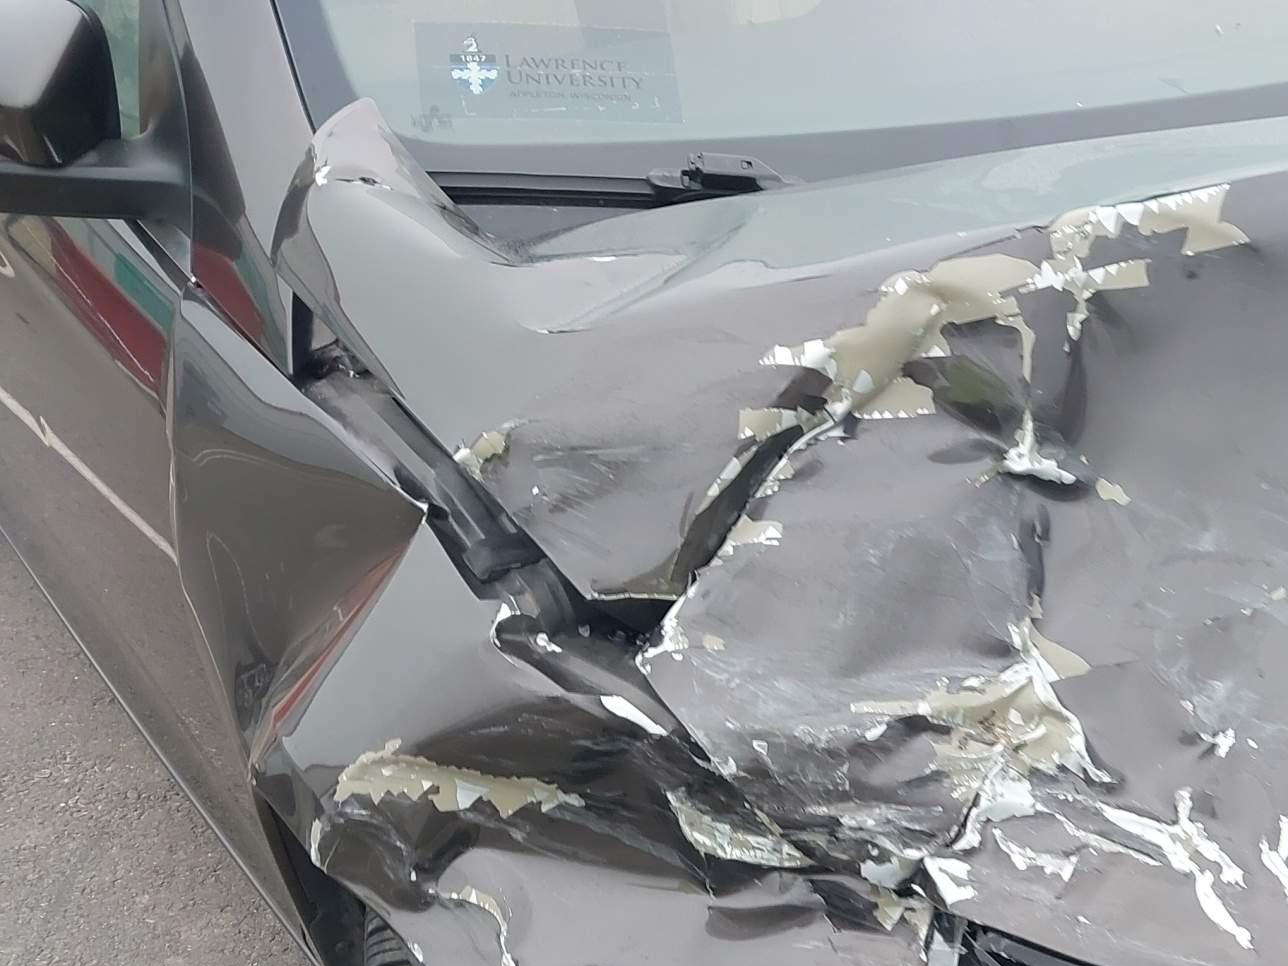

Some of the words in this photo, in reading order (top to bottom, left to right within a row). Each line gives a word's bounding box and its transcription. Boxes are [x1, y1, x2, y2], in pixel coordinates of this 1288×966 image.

[460, 54, 487, 63] 1847
[504, 54, 627, 73] LAWRENCE
[506, 72, 644, 90] UNIVERSITY
